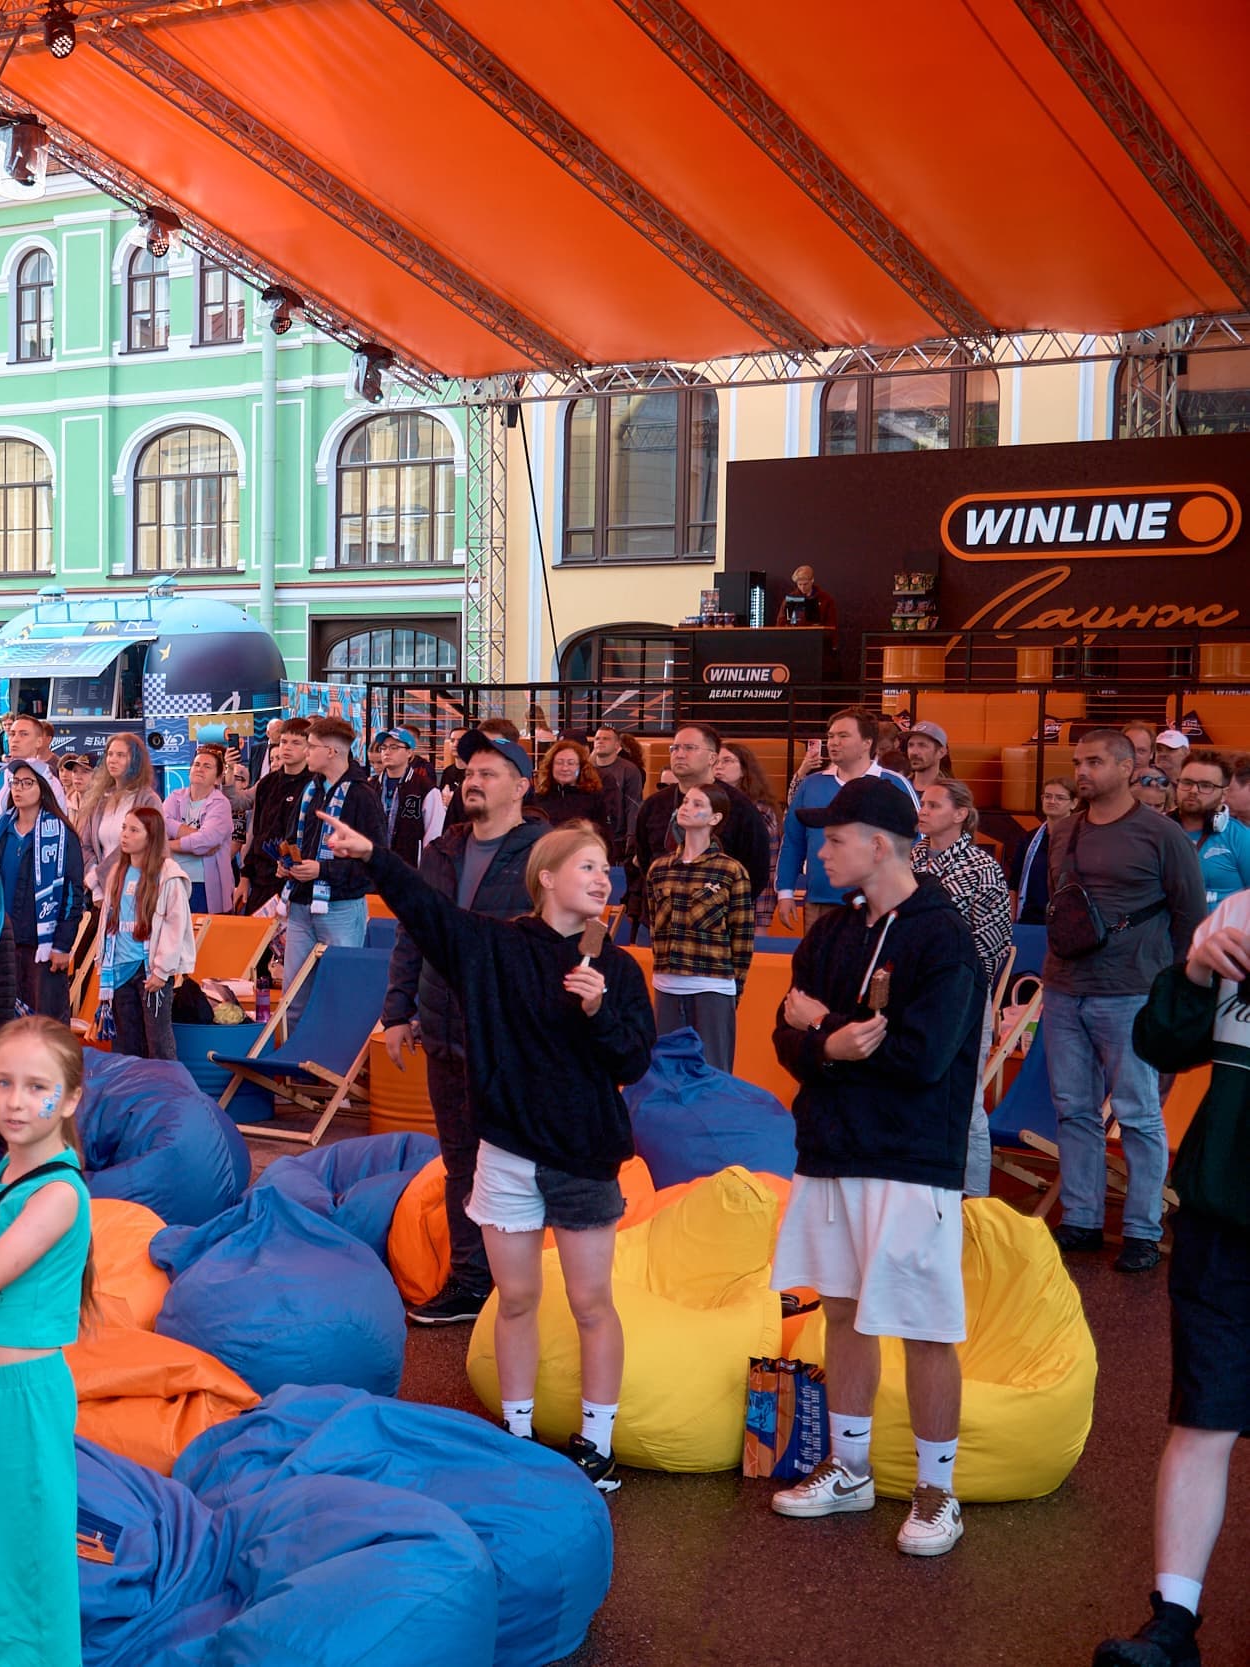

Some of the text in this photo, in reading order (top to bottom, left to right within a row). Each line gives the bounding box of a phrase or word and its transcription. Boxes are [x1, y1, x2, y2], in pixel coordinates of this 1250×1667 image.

[966, 502, 1171, 546] WINLINE
[945, 565, 1239, 657] Лаунж
[710, 668, 770, 682] WINLINE
[709, 690, 783, 699] ДЕЛАЕТ РАЗНИЦУ
